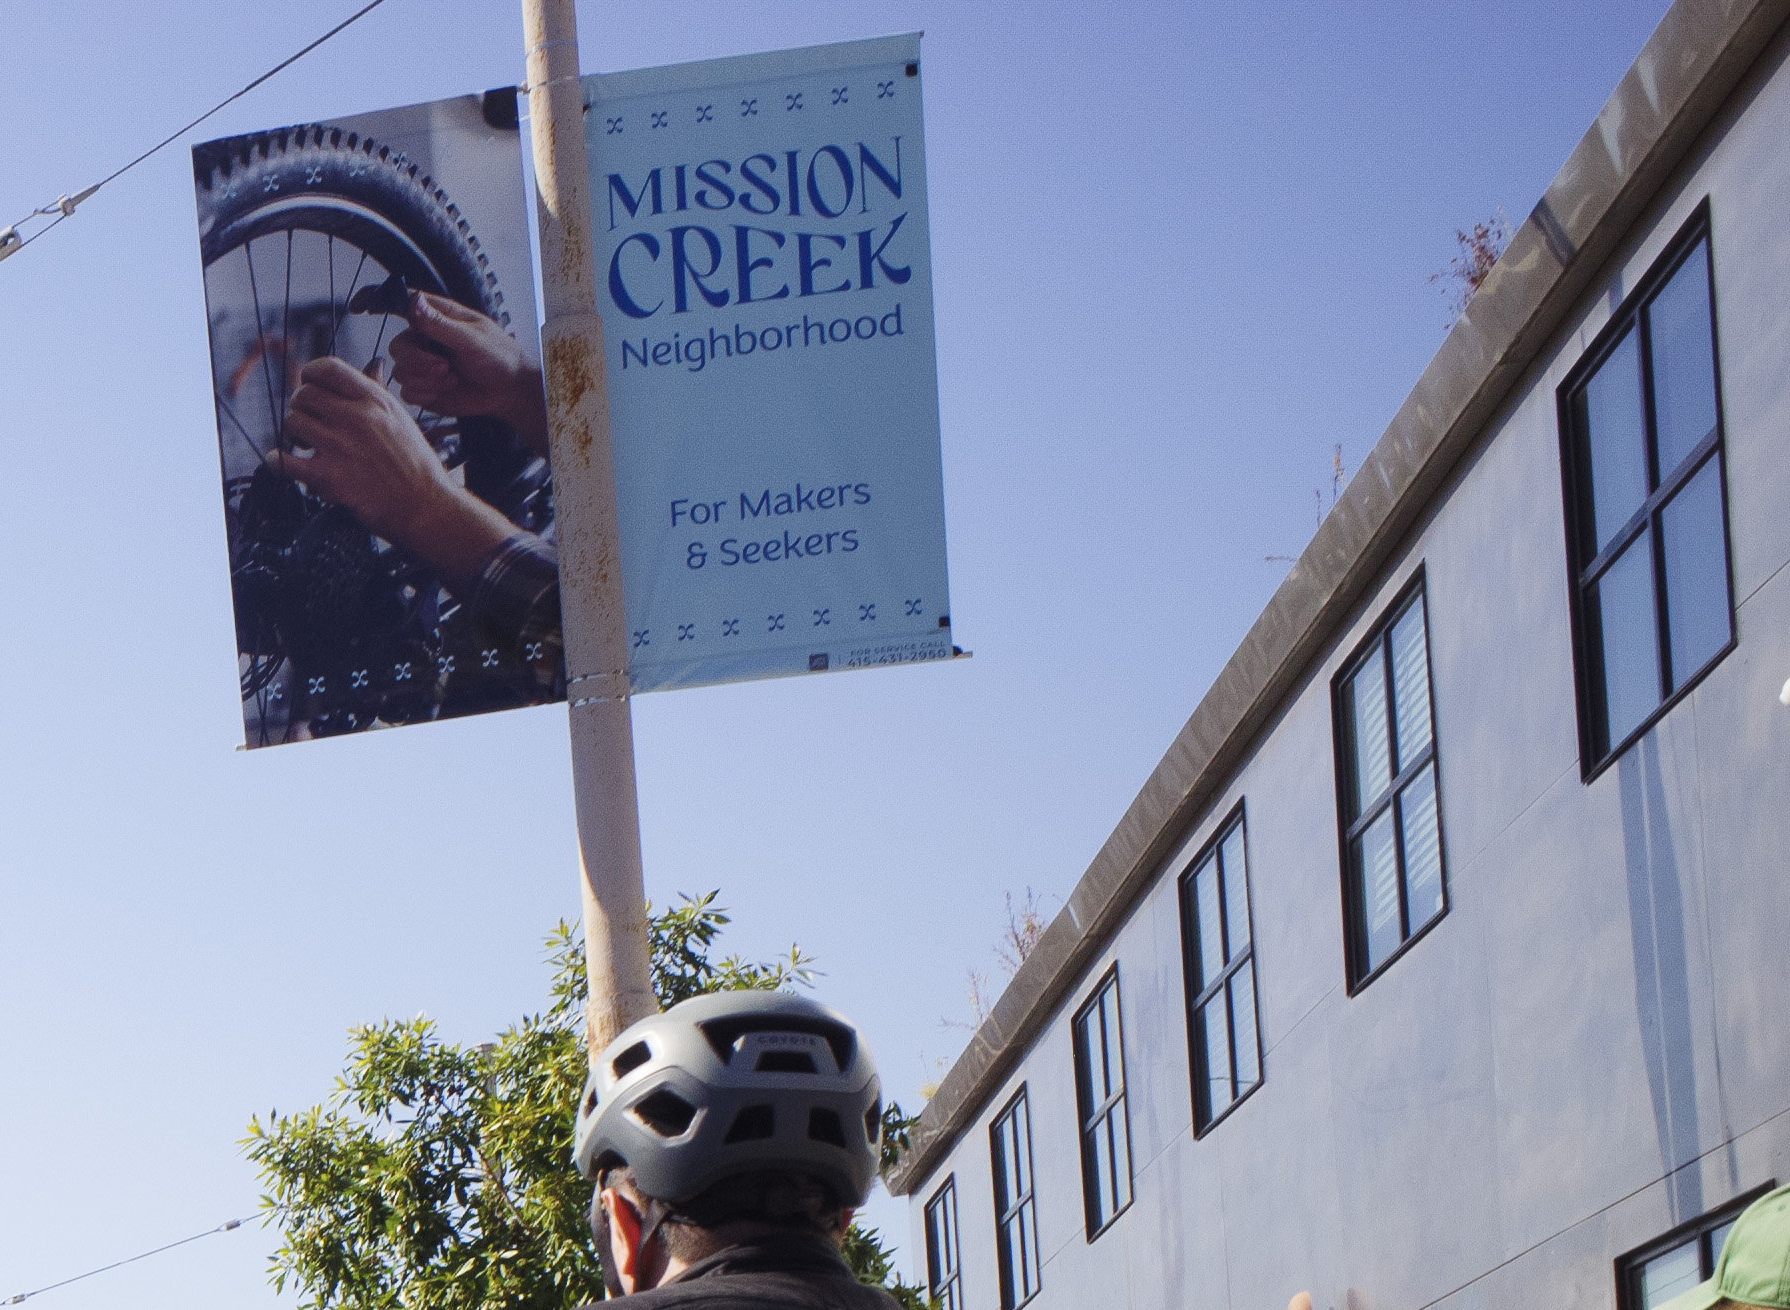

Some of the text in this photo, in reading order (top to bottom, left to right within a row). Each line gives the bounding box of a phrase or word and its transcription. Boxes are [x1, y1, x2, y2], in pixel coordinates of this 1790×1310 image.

[606, 136, 905, 231] MISSION
[607, 213, 912, 319] CREEK
[621, 304, 904, 372] Neighborhood
[670, 481, 872, 529] For Makers
[687, 526, 859, 570] & Seekers
